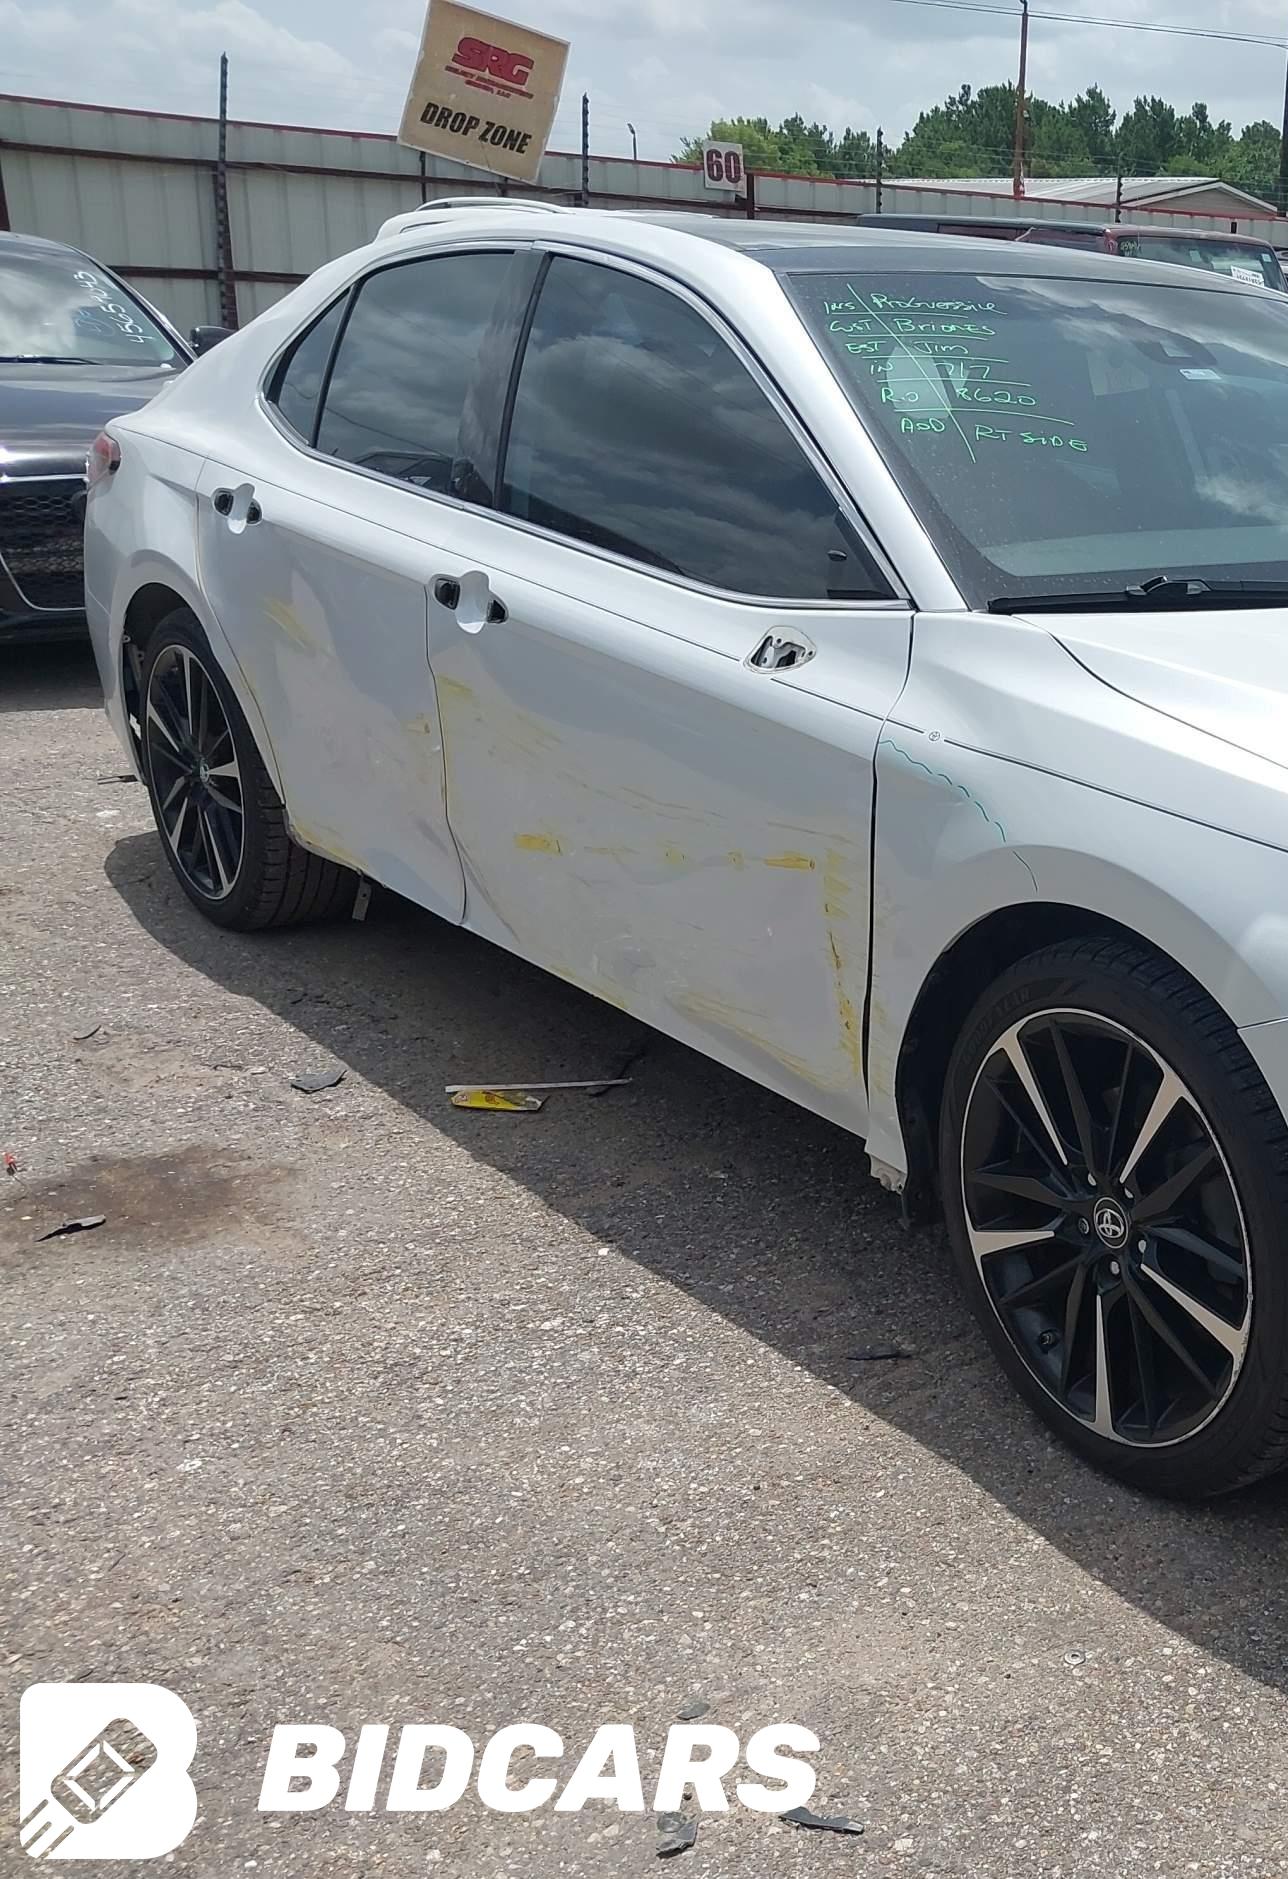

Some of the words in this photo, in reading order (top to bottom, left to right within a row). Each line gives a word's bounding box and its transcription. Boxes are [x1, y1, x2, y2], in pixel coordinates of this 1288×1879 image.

[452, 37, 534, 85] SRG
[420, 102, 480, 136] DROP
[478, 121, 532, 154] ZONE
[706, 149, 741, 183] 60
